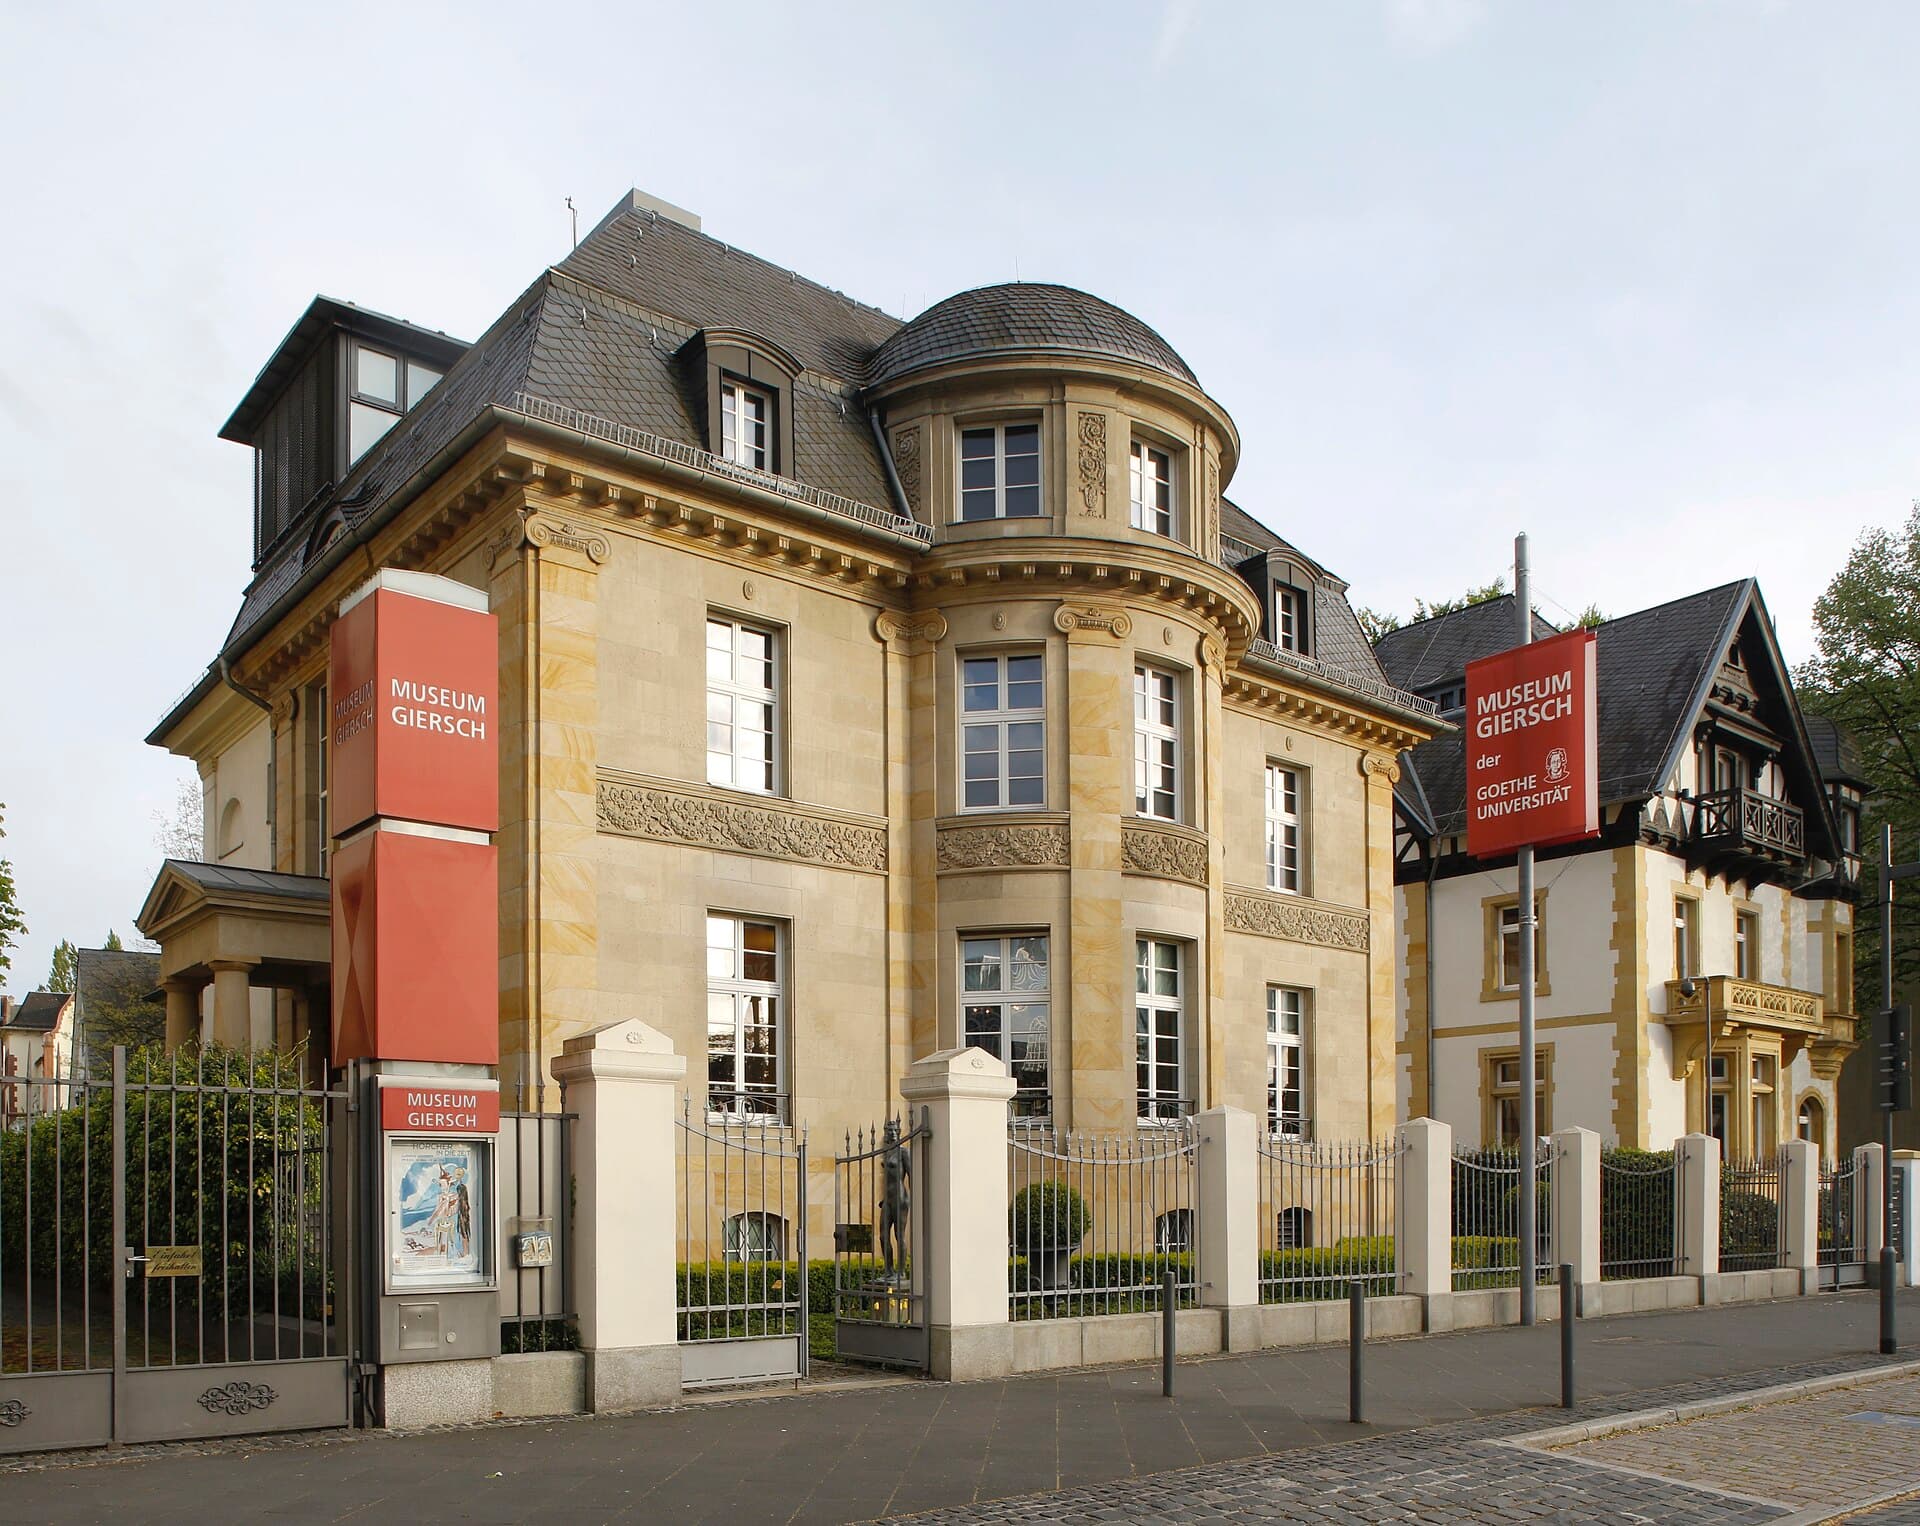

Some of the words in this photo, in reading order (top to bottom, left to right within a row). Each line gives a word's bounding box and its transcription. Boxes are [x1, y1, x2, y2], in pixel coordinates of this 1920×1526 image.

[335, 680, 373, 721] MUSEUM
[391, 678, 485, 714] MUSEUM
[1477, 670, 1572, 715] MUSEUM
[335, 706, 373, 745] GIERSCH
[391, 706, 485, 740] GIERSCH
[1476, 694, 1573, 739] GIERSCH
[1476, 754, 1501, 770] der
[1477, 774, 1537, 801] GOETHE
[1477, 785, 1573, 820] UNIVERSITÄT
[407, 1092, 477, 1108] MUSEUM
[407, 1112, 477, 1127] GIERSCH
